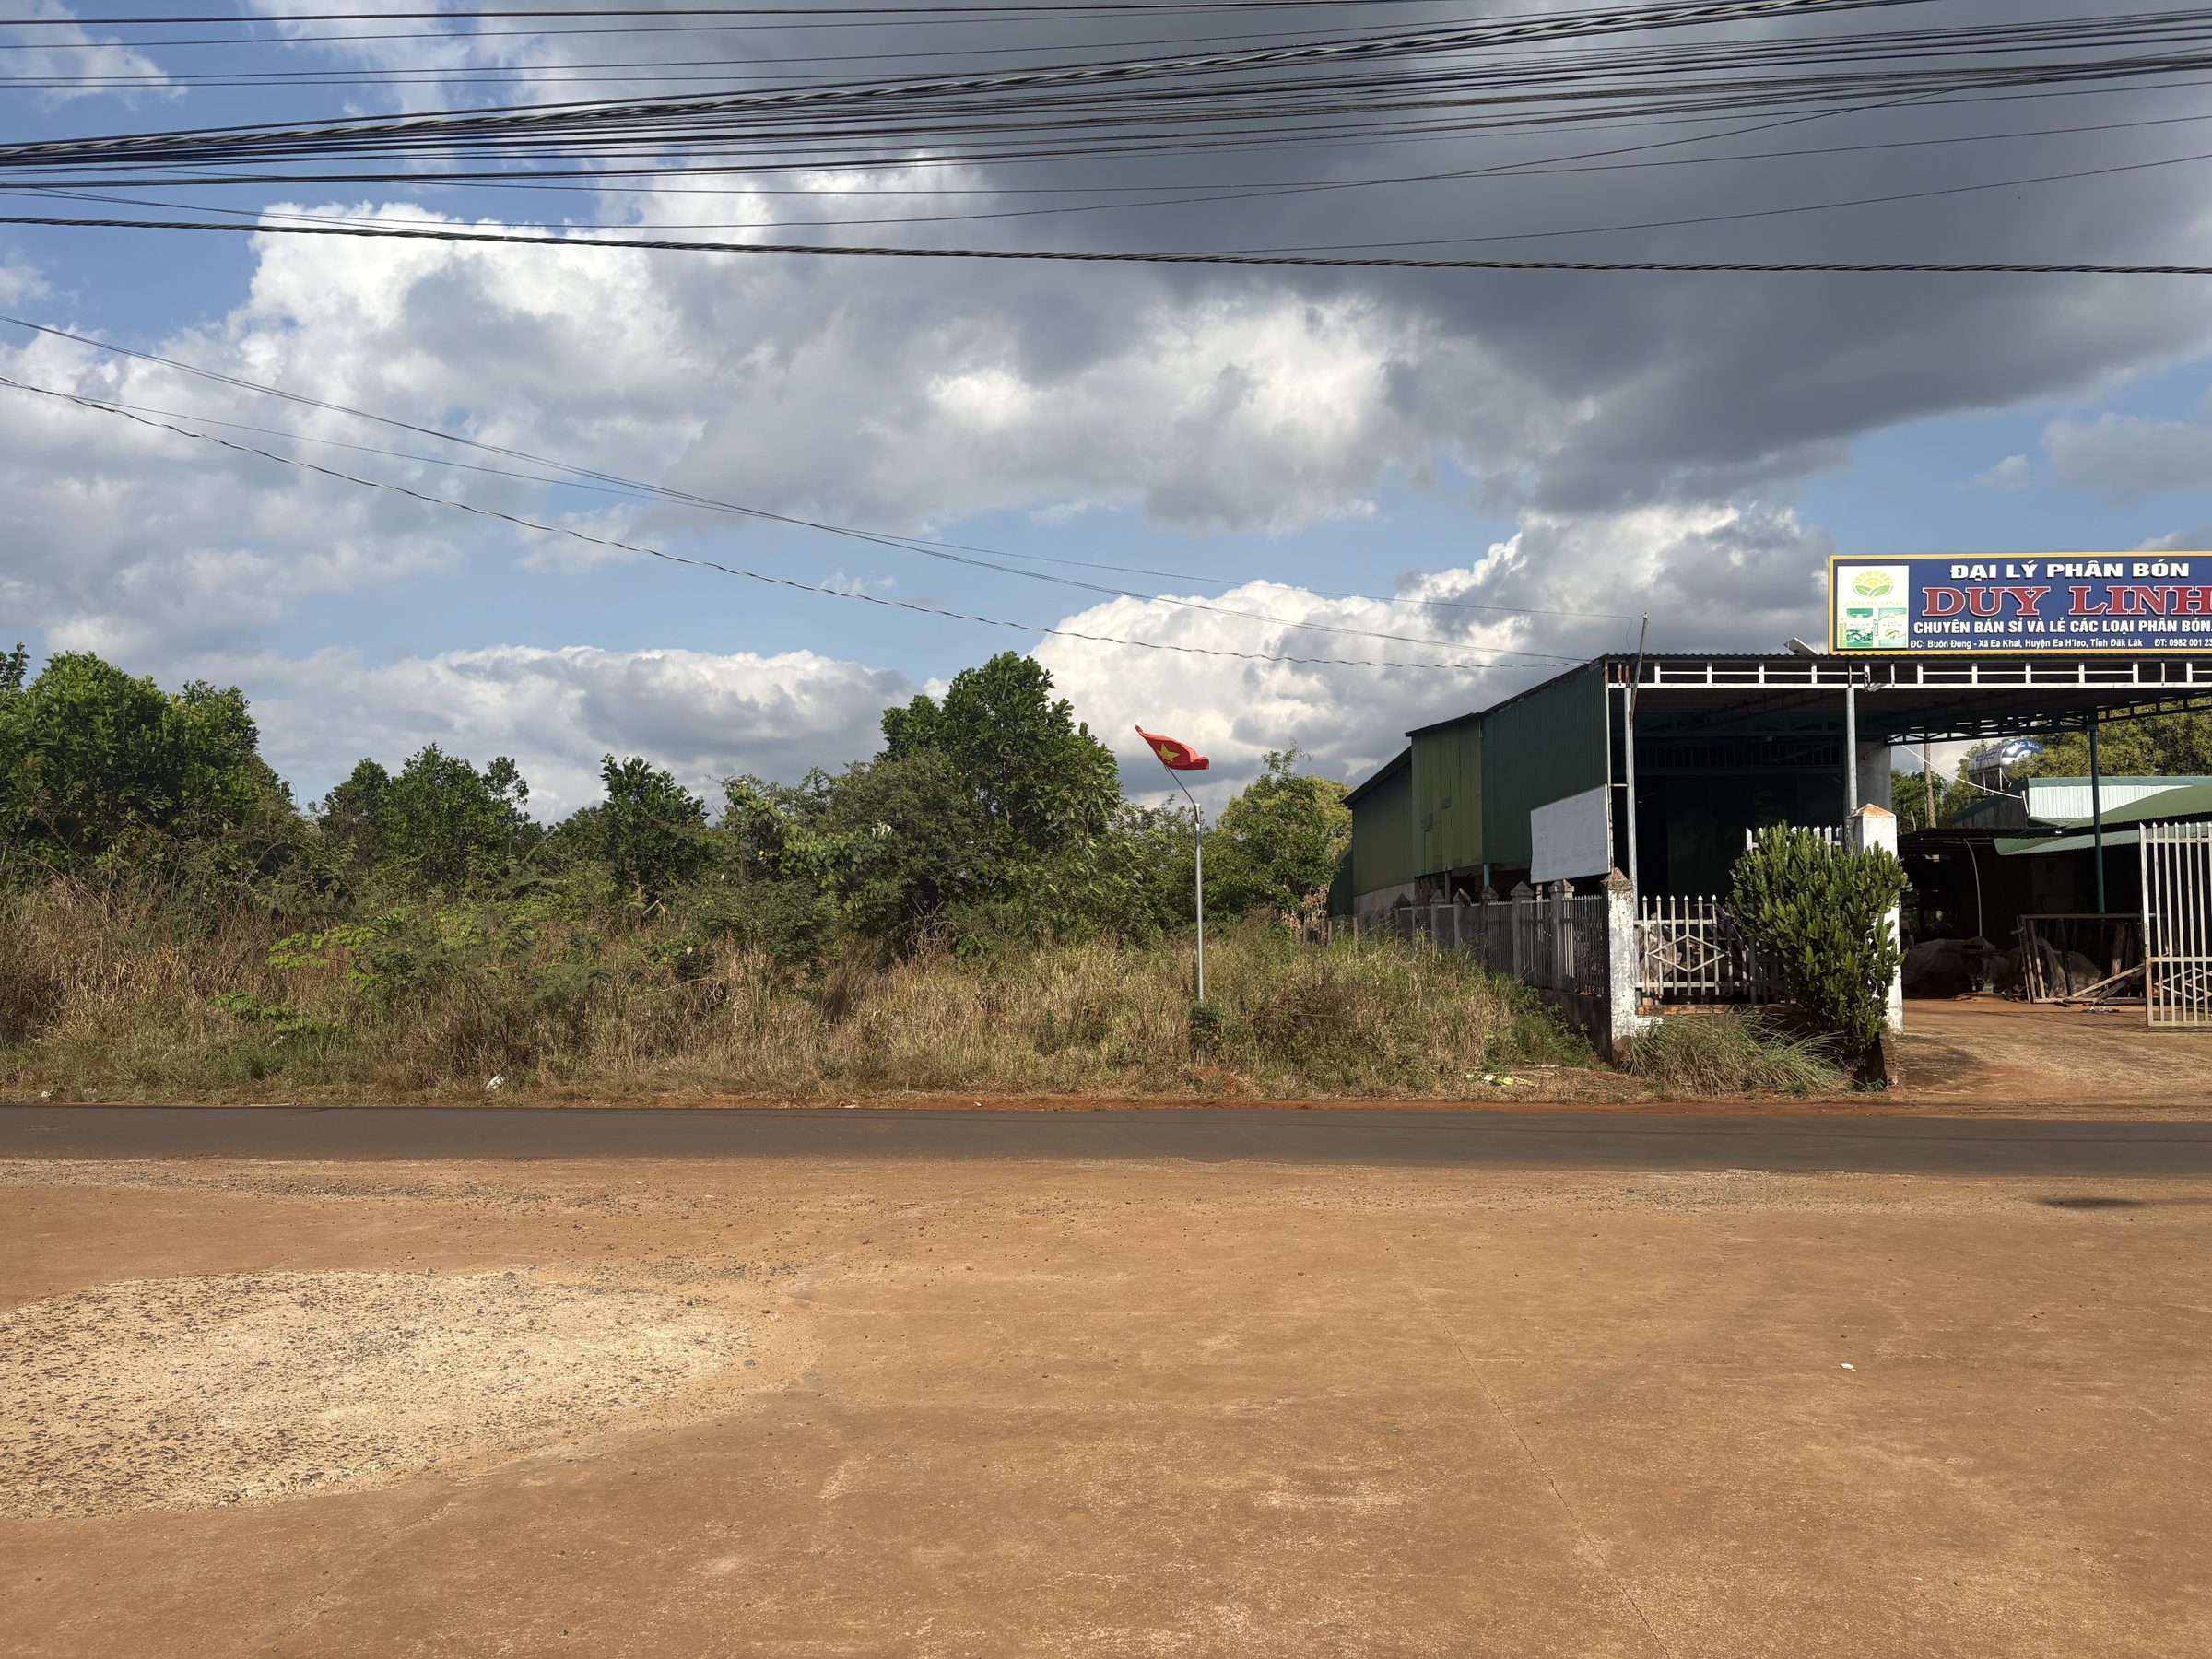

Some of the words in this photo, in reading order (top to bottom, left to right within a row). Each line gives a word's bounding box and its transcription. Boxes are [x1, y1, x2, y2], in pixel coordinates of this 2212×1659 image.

[1950, 564, 1997, 582] ĐẠI
[2006, 559, 2038, 579] LÝ
[2046, 559, 2124, 578] PHÂN
[2132, 559, 2190, 578] BÓN
[1922, 585, 2051, 617] DUY
[2068, 585, 2212, 616] LINH
[1913, 618, 1971, 634] CHUYÊN
[1973, 618, 2005, 633] BÁN
[2007, 617, 2023, 633] SỈ
[2026, 618, 2045, 633] VÀ
[2049, 617, 2065, 633] LẺ
[2070, 618, 2099, 633] CÁC
[2102, 619, 2134, 635] LOẠI
[2138, 618, 2177, 633] PHÂN
[1910, 639, 1925, 648] ĐC:
[1927, 639, 1948, 648] Buôn
[1950, 639, 1972, 650] Đung
[1990, 639, 2001, 648] Ea
[2025, 638, 2051, 649] Huyện
[2053, 639, 2064, 648] Ea
[2154, 638, 2167, 647] ĐT:
[2169, 638, 2188, 647] 0982
[2188, 638, 2203, 647] 001
